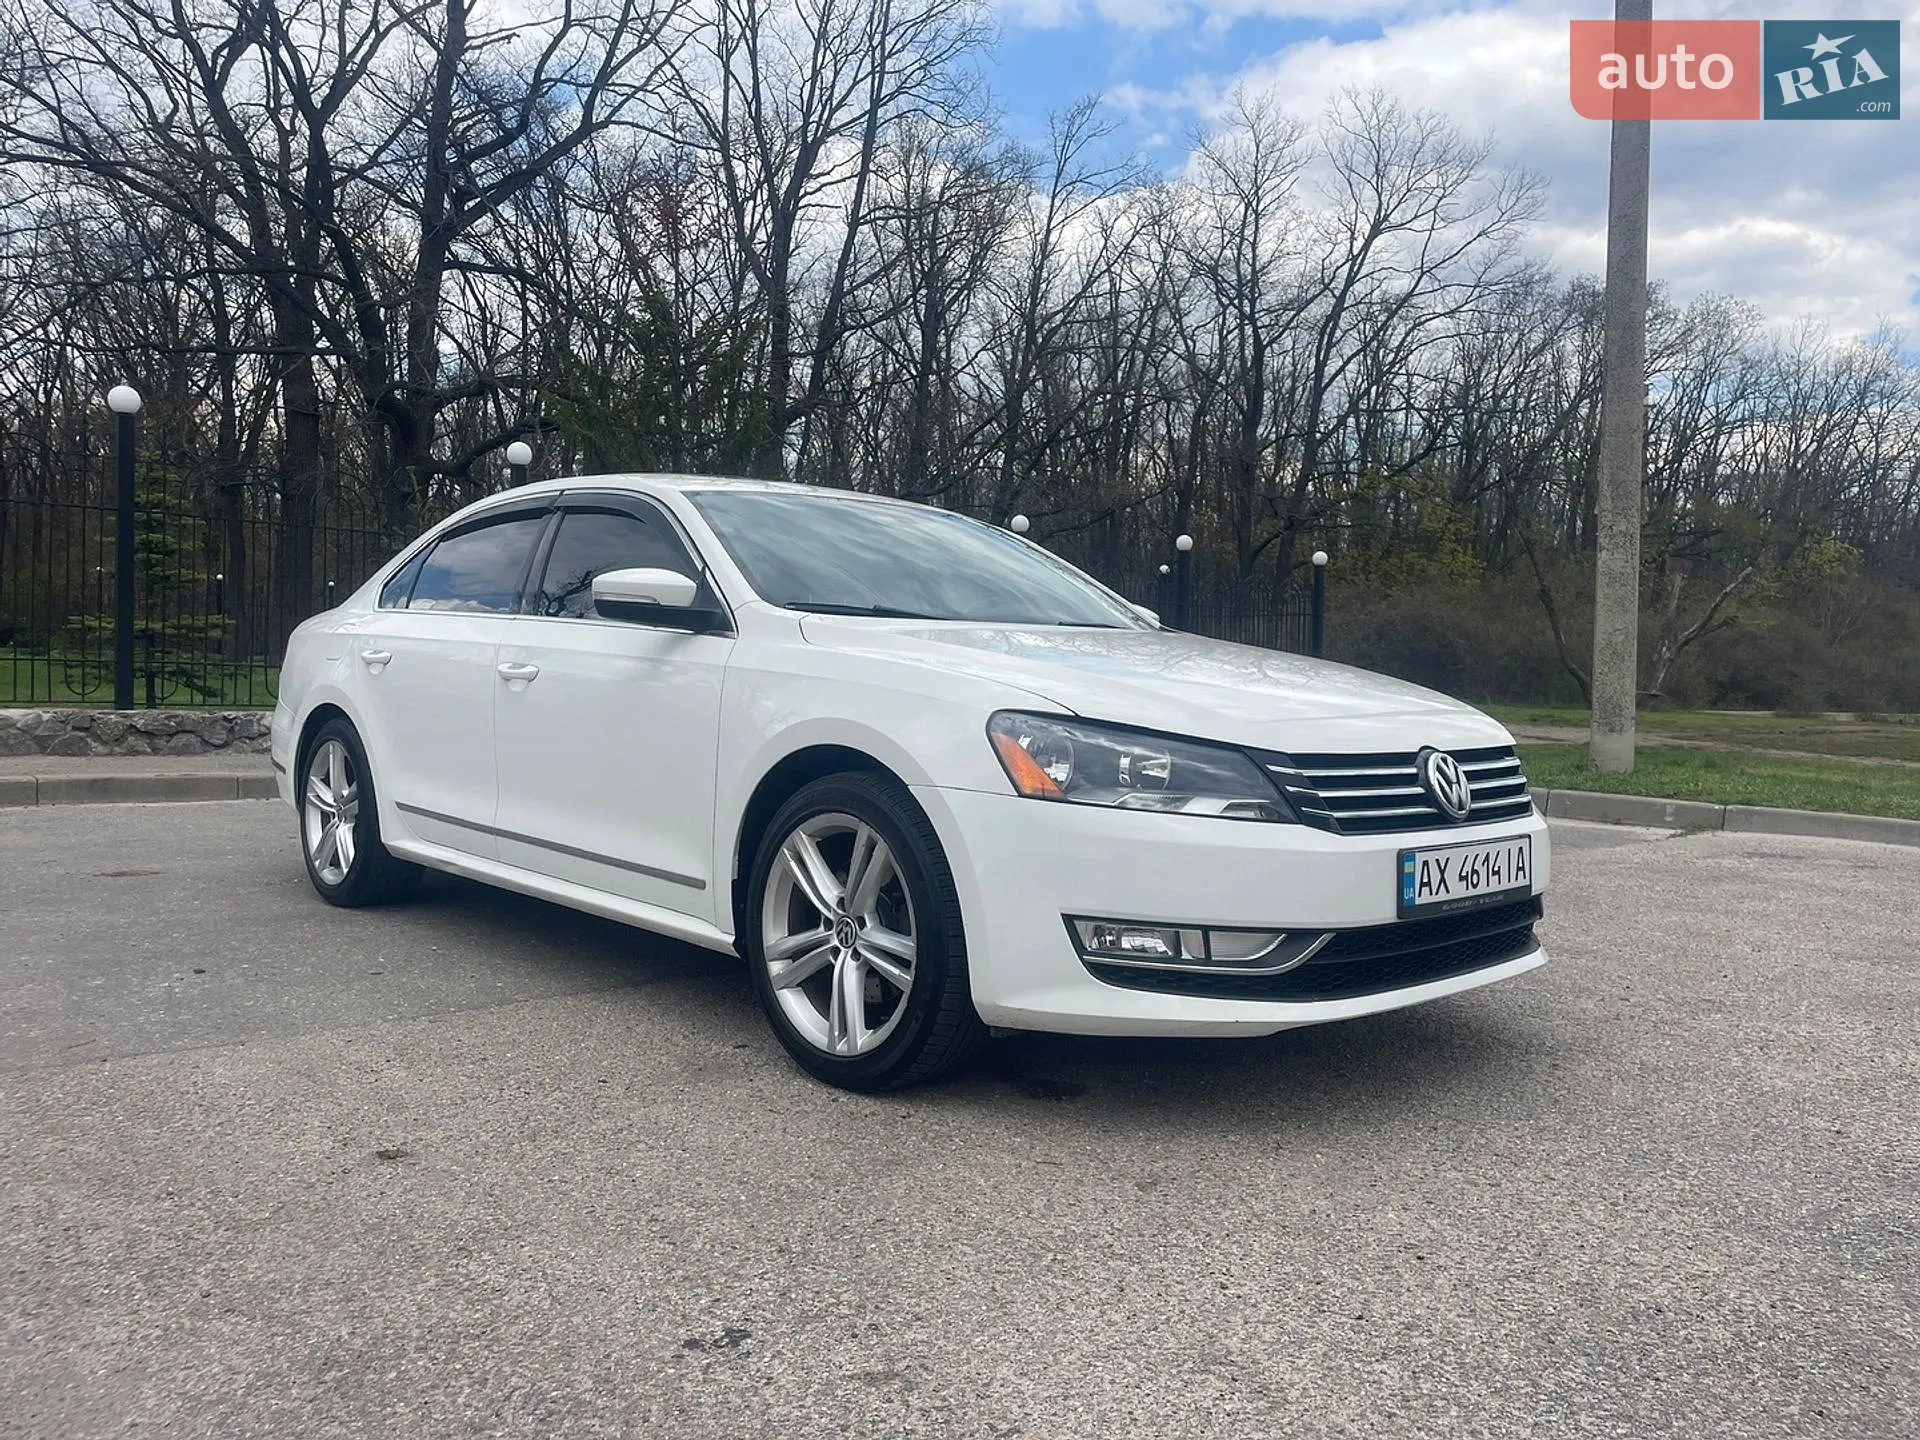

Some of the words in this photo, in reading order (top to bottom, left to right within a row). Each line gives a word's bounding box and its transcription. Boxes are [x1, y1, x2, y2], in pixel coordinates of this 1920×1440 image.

[1418, 857, 1450, 898] AX
[1459, 850, 1502, 891] 4614
[1507, 846, 1527, 883] IA
[1403, 887, 1415, 900] UA
